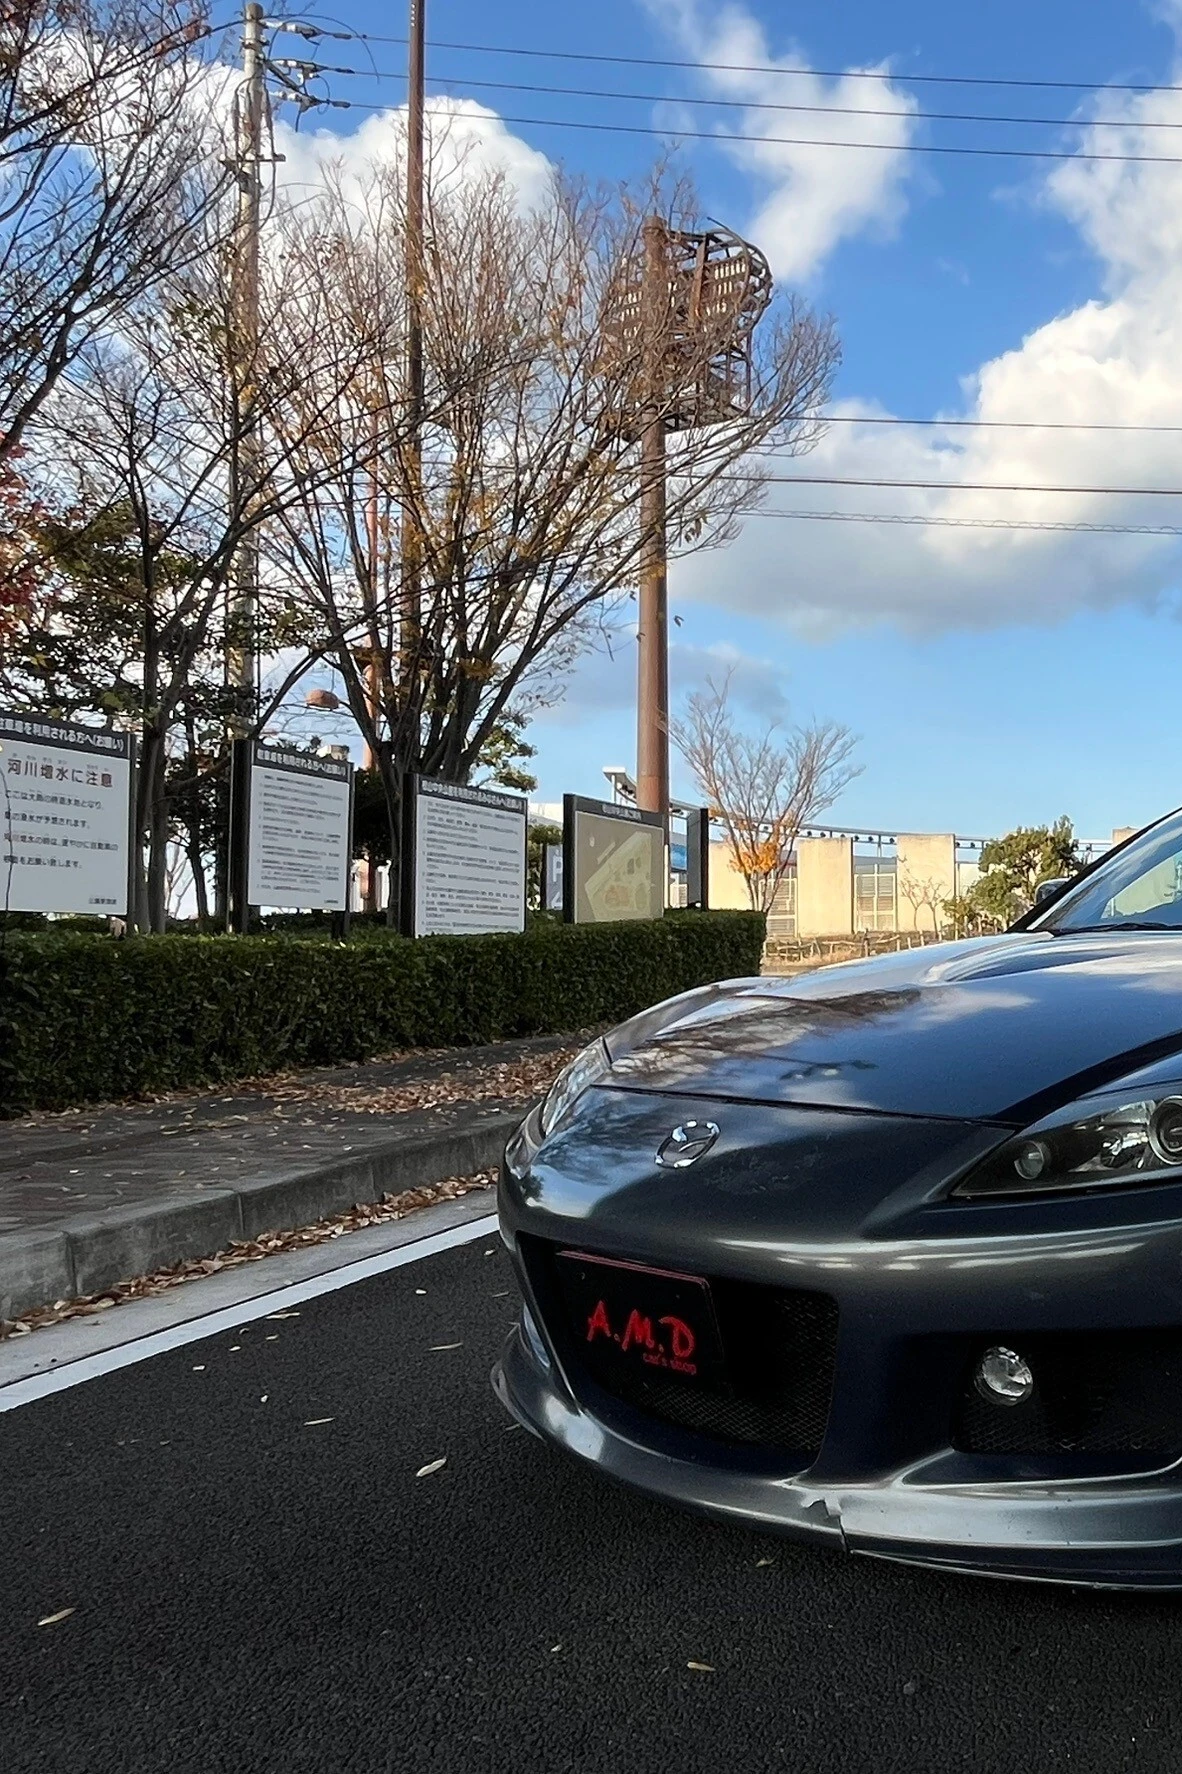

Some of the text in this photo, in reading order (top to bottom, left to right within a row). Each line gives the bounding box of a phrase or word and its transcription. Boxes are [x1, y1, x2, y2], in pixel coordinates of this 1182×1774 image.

[8, 758, 113, 788] 河川増水に注意
[586, 1300, 695, 1357] A.M.D
